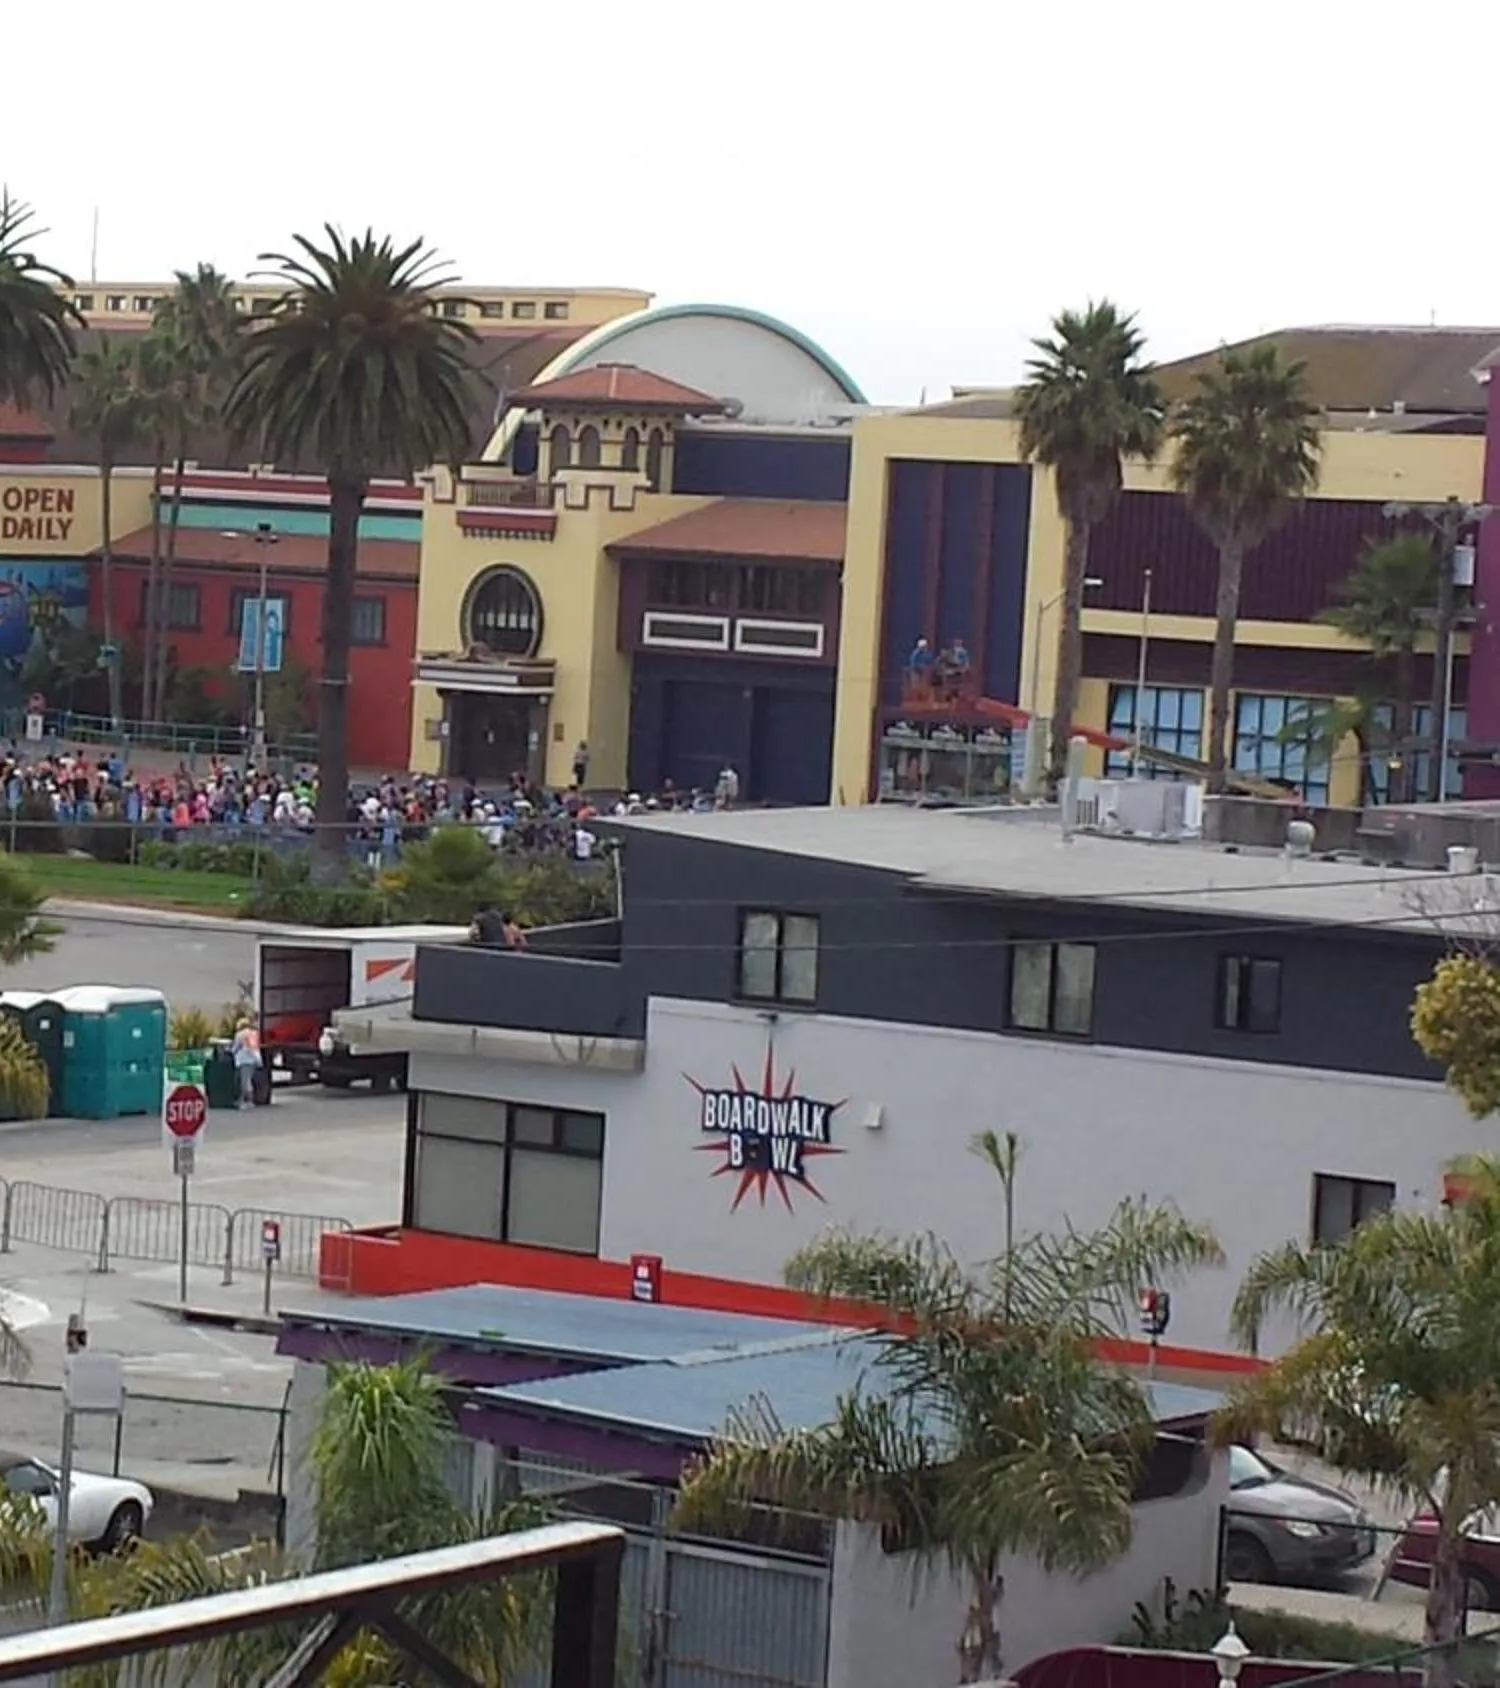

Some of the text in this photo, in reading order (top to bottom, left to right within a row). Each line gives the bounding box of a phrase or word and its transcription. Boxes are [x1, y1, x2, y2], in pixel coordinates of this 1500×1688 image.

[2, 486, 75, 512] OPEN
[2, 516, 74, 540] DAILY
[168, 1100, 204, 1122] STOP
[704, 1094, 825, 1141] BOARDWALK
